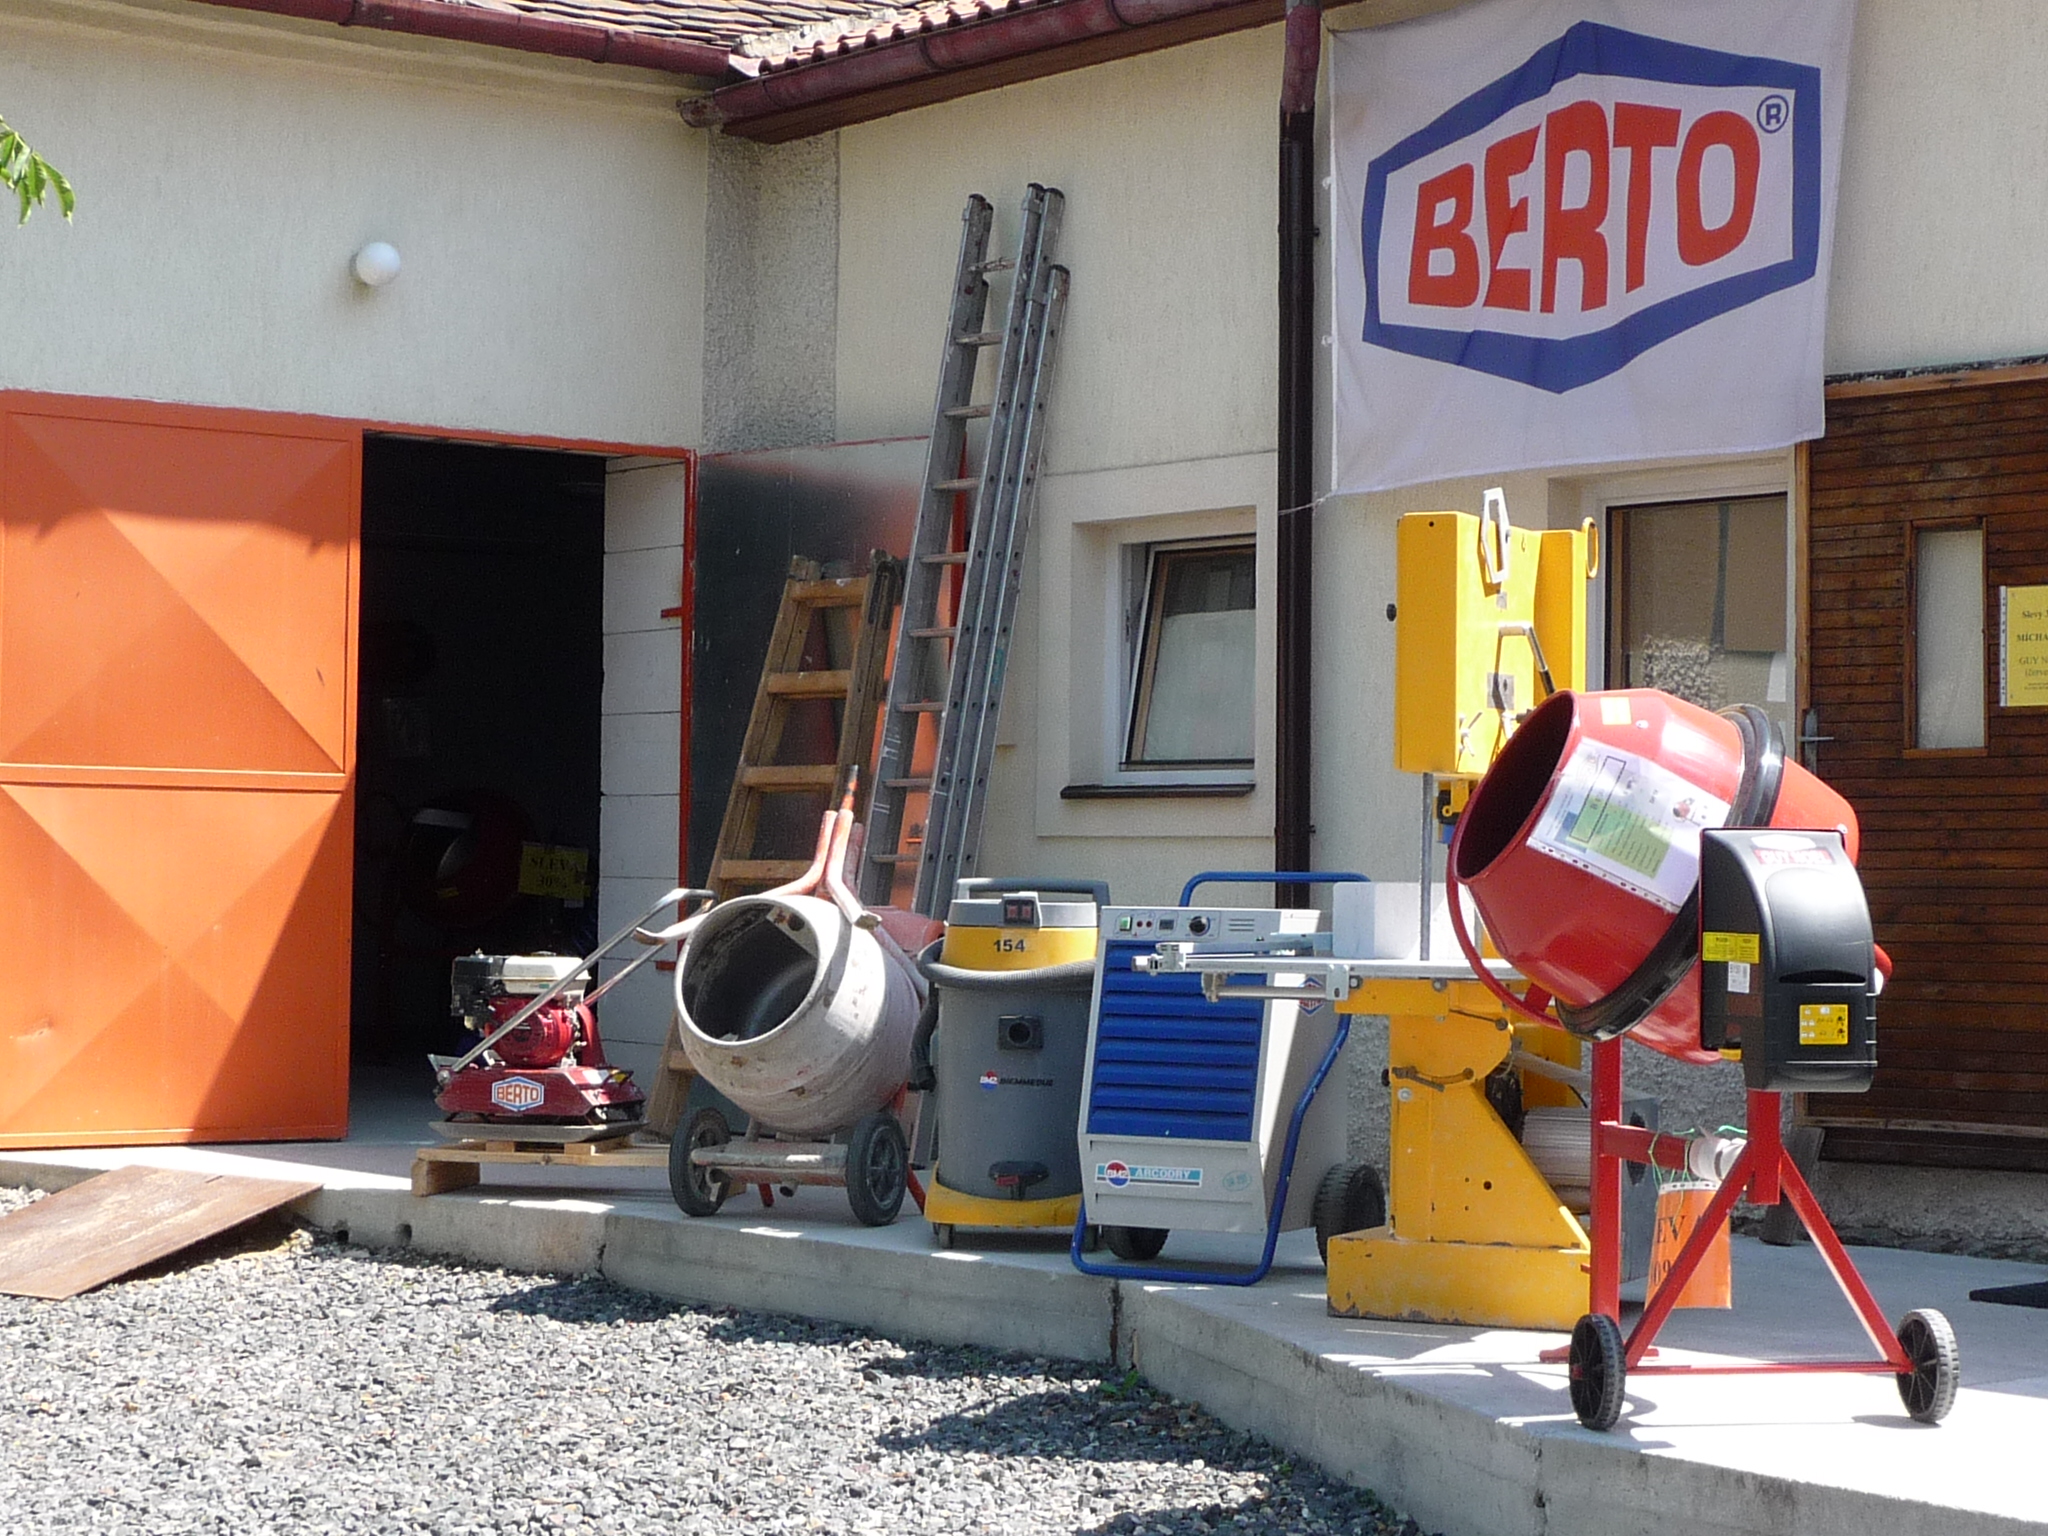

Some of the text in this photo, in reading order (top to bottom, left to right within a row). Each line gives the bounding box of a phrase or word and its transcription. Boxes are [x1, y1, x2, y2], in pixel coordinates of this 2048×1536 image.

[1407, 100, 1760, 314] BERTO
[993, 939, 1025, 952] 154
[497, 1083, 540, 1104] BERTO
